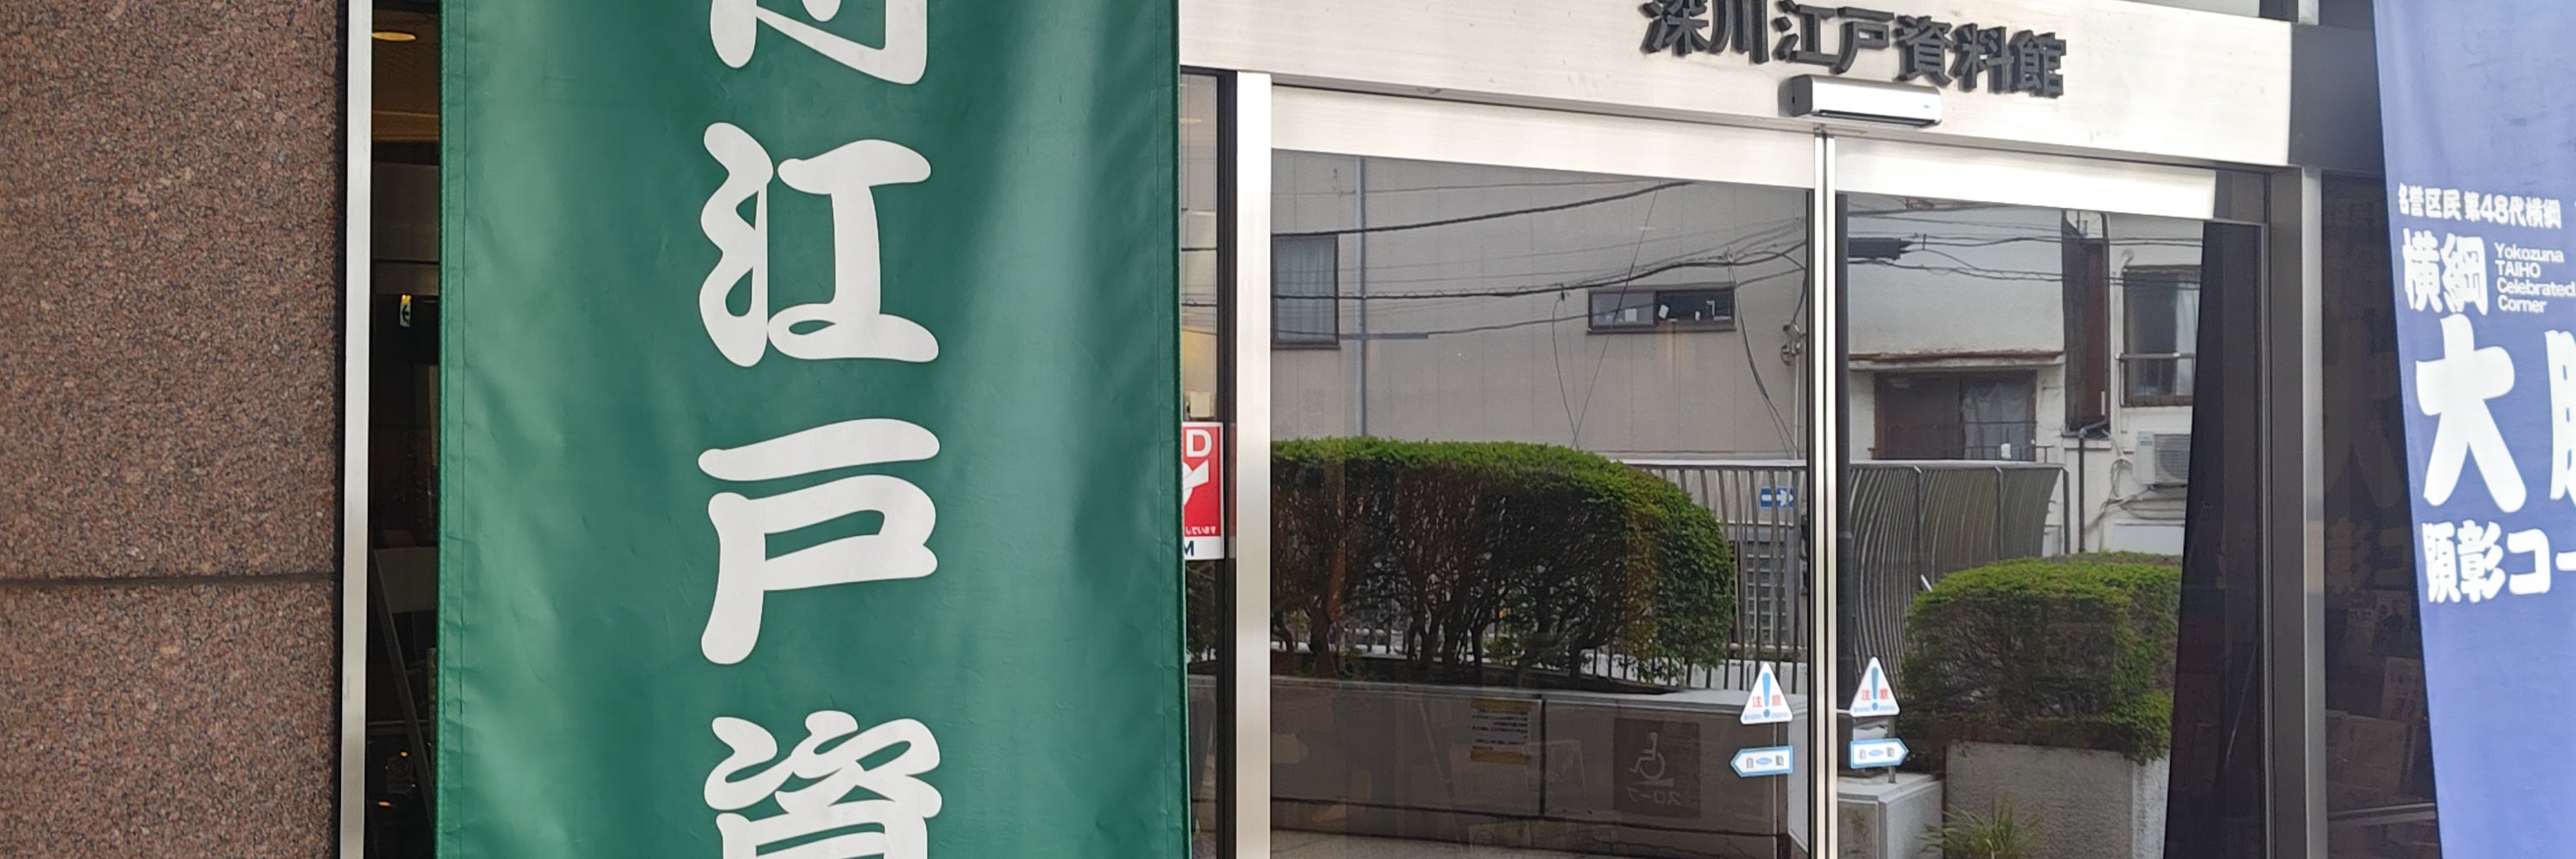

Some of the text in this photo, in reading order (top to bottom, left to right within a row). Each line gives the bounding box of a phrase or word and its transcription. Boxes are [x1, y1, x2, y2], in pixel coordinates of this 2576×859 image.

[1641, 0, 2066, 98] 深川江戸資料館
[2494, 242, 2565, 263] Yokozuna
[2401, 228, 2489, 315] 横綱
[2495, 260, 2541, 279] TAIHO
[2496, 276, 2576, 298] Celebrated
[2498, 294, 2548, 313] Corner
[2415, 313, 2576, 513] 大
